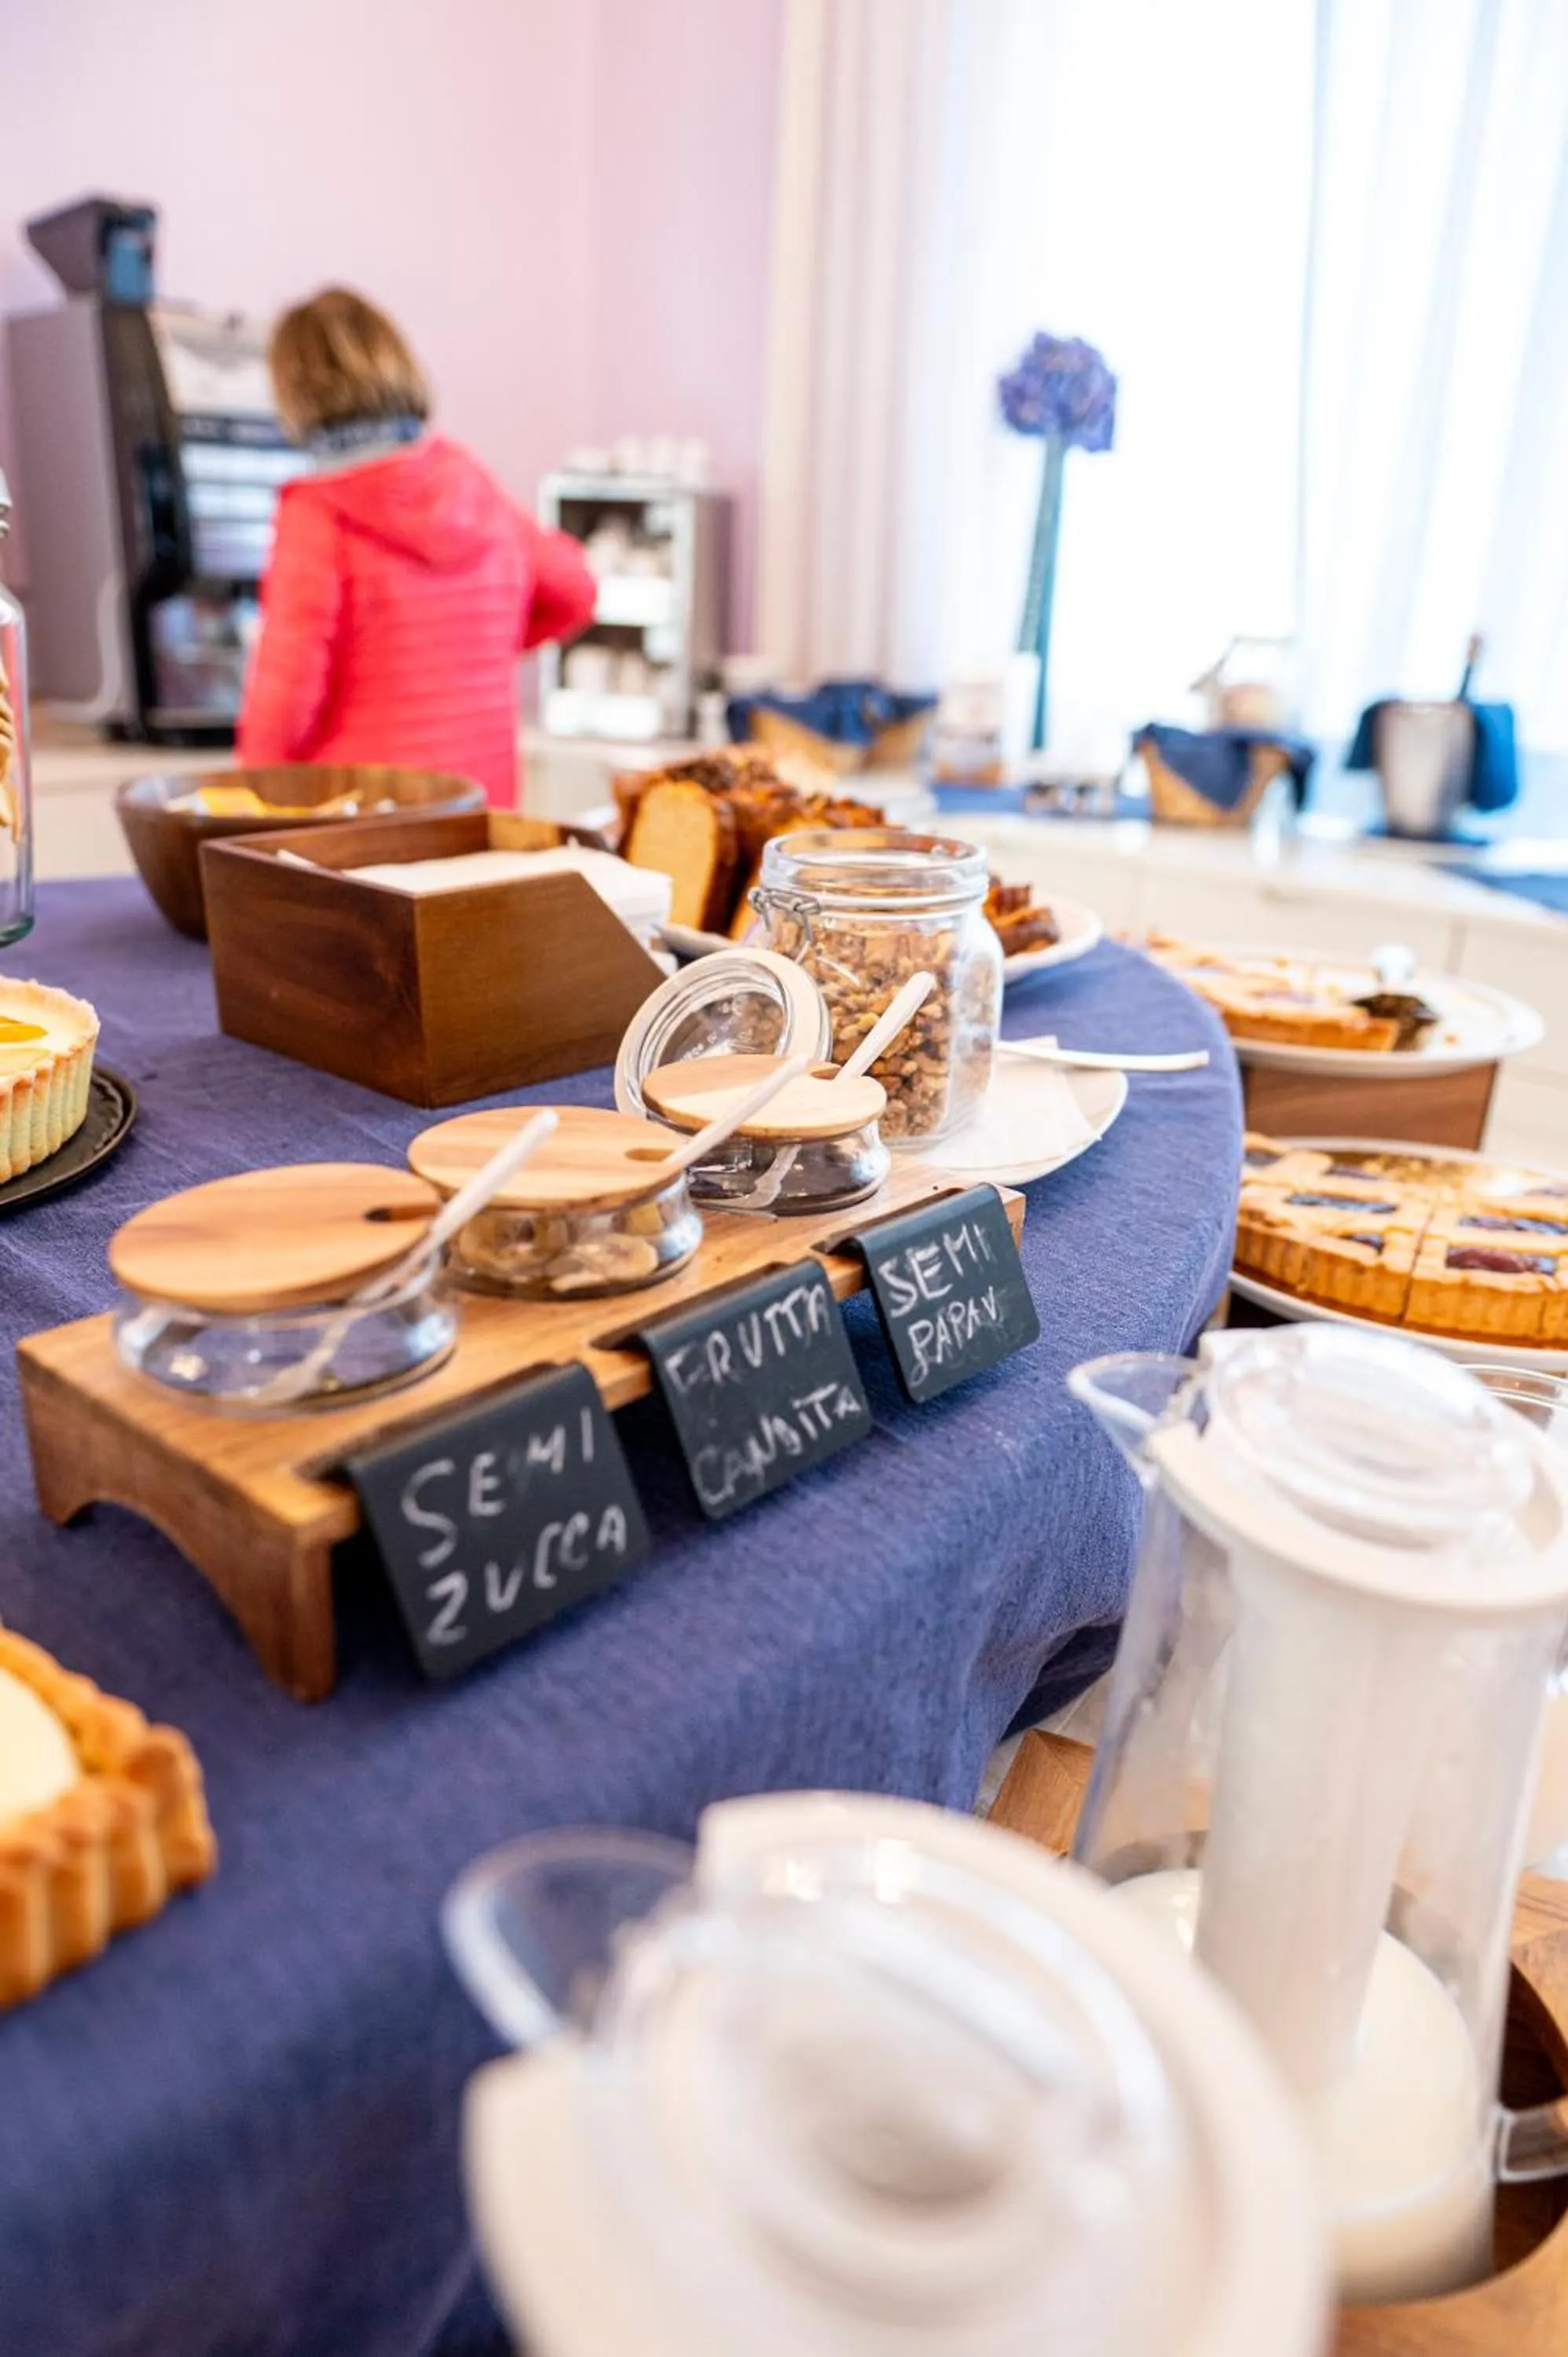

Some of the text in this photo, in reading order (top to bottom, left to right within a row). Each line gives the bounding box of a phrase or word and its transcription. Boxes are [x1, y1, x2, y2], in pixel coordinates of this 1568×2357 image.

[877, 1222, 995, 1318] SEMI
[401, 1406, 595, 1570] SEMI
[425, 1504, 628, 1645] ZUCCA
